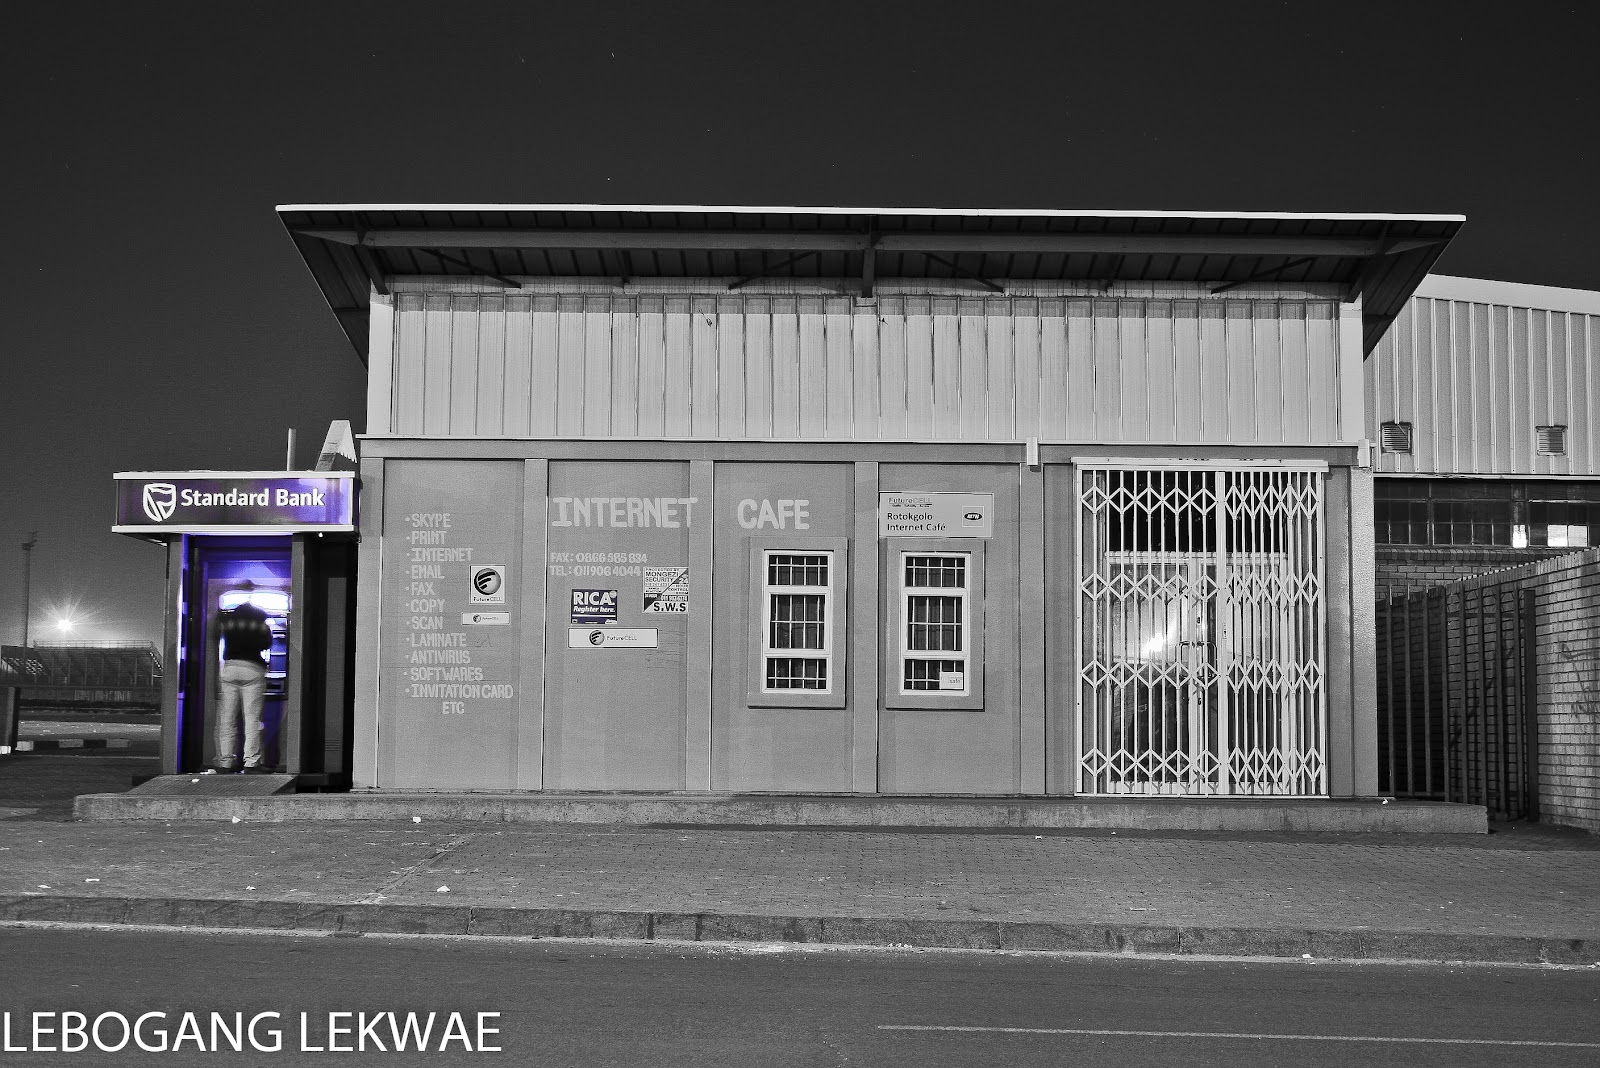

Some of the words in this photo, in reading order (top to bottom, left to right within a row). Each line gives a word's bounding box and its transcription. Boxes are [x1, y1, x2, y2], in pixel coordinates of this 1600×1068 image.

[180, 488, 269, 507] Standard
[276, 488, 325, 507] Bank
[551, 496, 698, 528] INTERNET
[737, 498, 810, 530] CAFE
[887, 512, 933, 522] Rotokgolo
[411, 513, 451, 528] SKYPE
[887, 523, 923, 531] Internet
[926, 522, 946, 531] Café
[411, 530, 447, 545] PRINT
[411, 547, 473, 562] INTERNET
[411, 564, 445, 579] EMAIL
[411, 581, 435, 596] FAX
[411, 598, 445, 613] COPY
[653, 602, 686, 612] S.W.S
[412, 615, 443, 630] SCAN
[411, 632, 467, 648] LAMINATE
[411, 649, 471, 664] ANTIVIRUS
[411, 666, 484, 681] SOFTWARES
[411, 683, 480, 698] INVITATION
[481, 684, 514, 699] CARD
[442, 701, 465, 715] ETC
